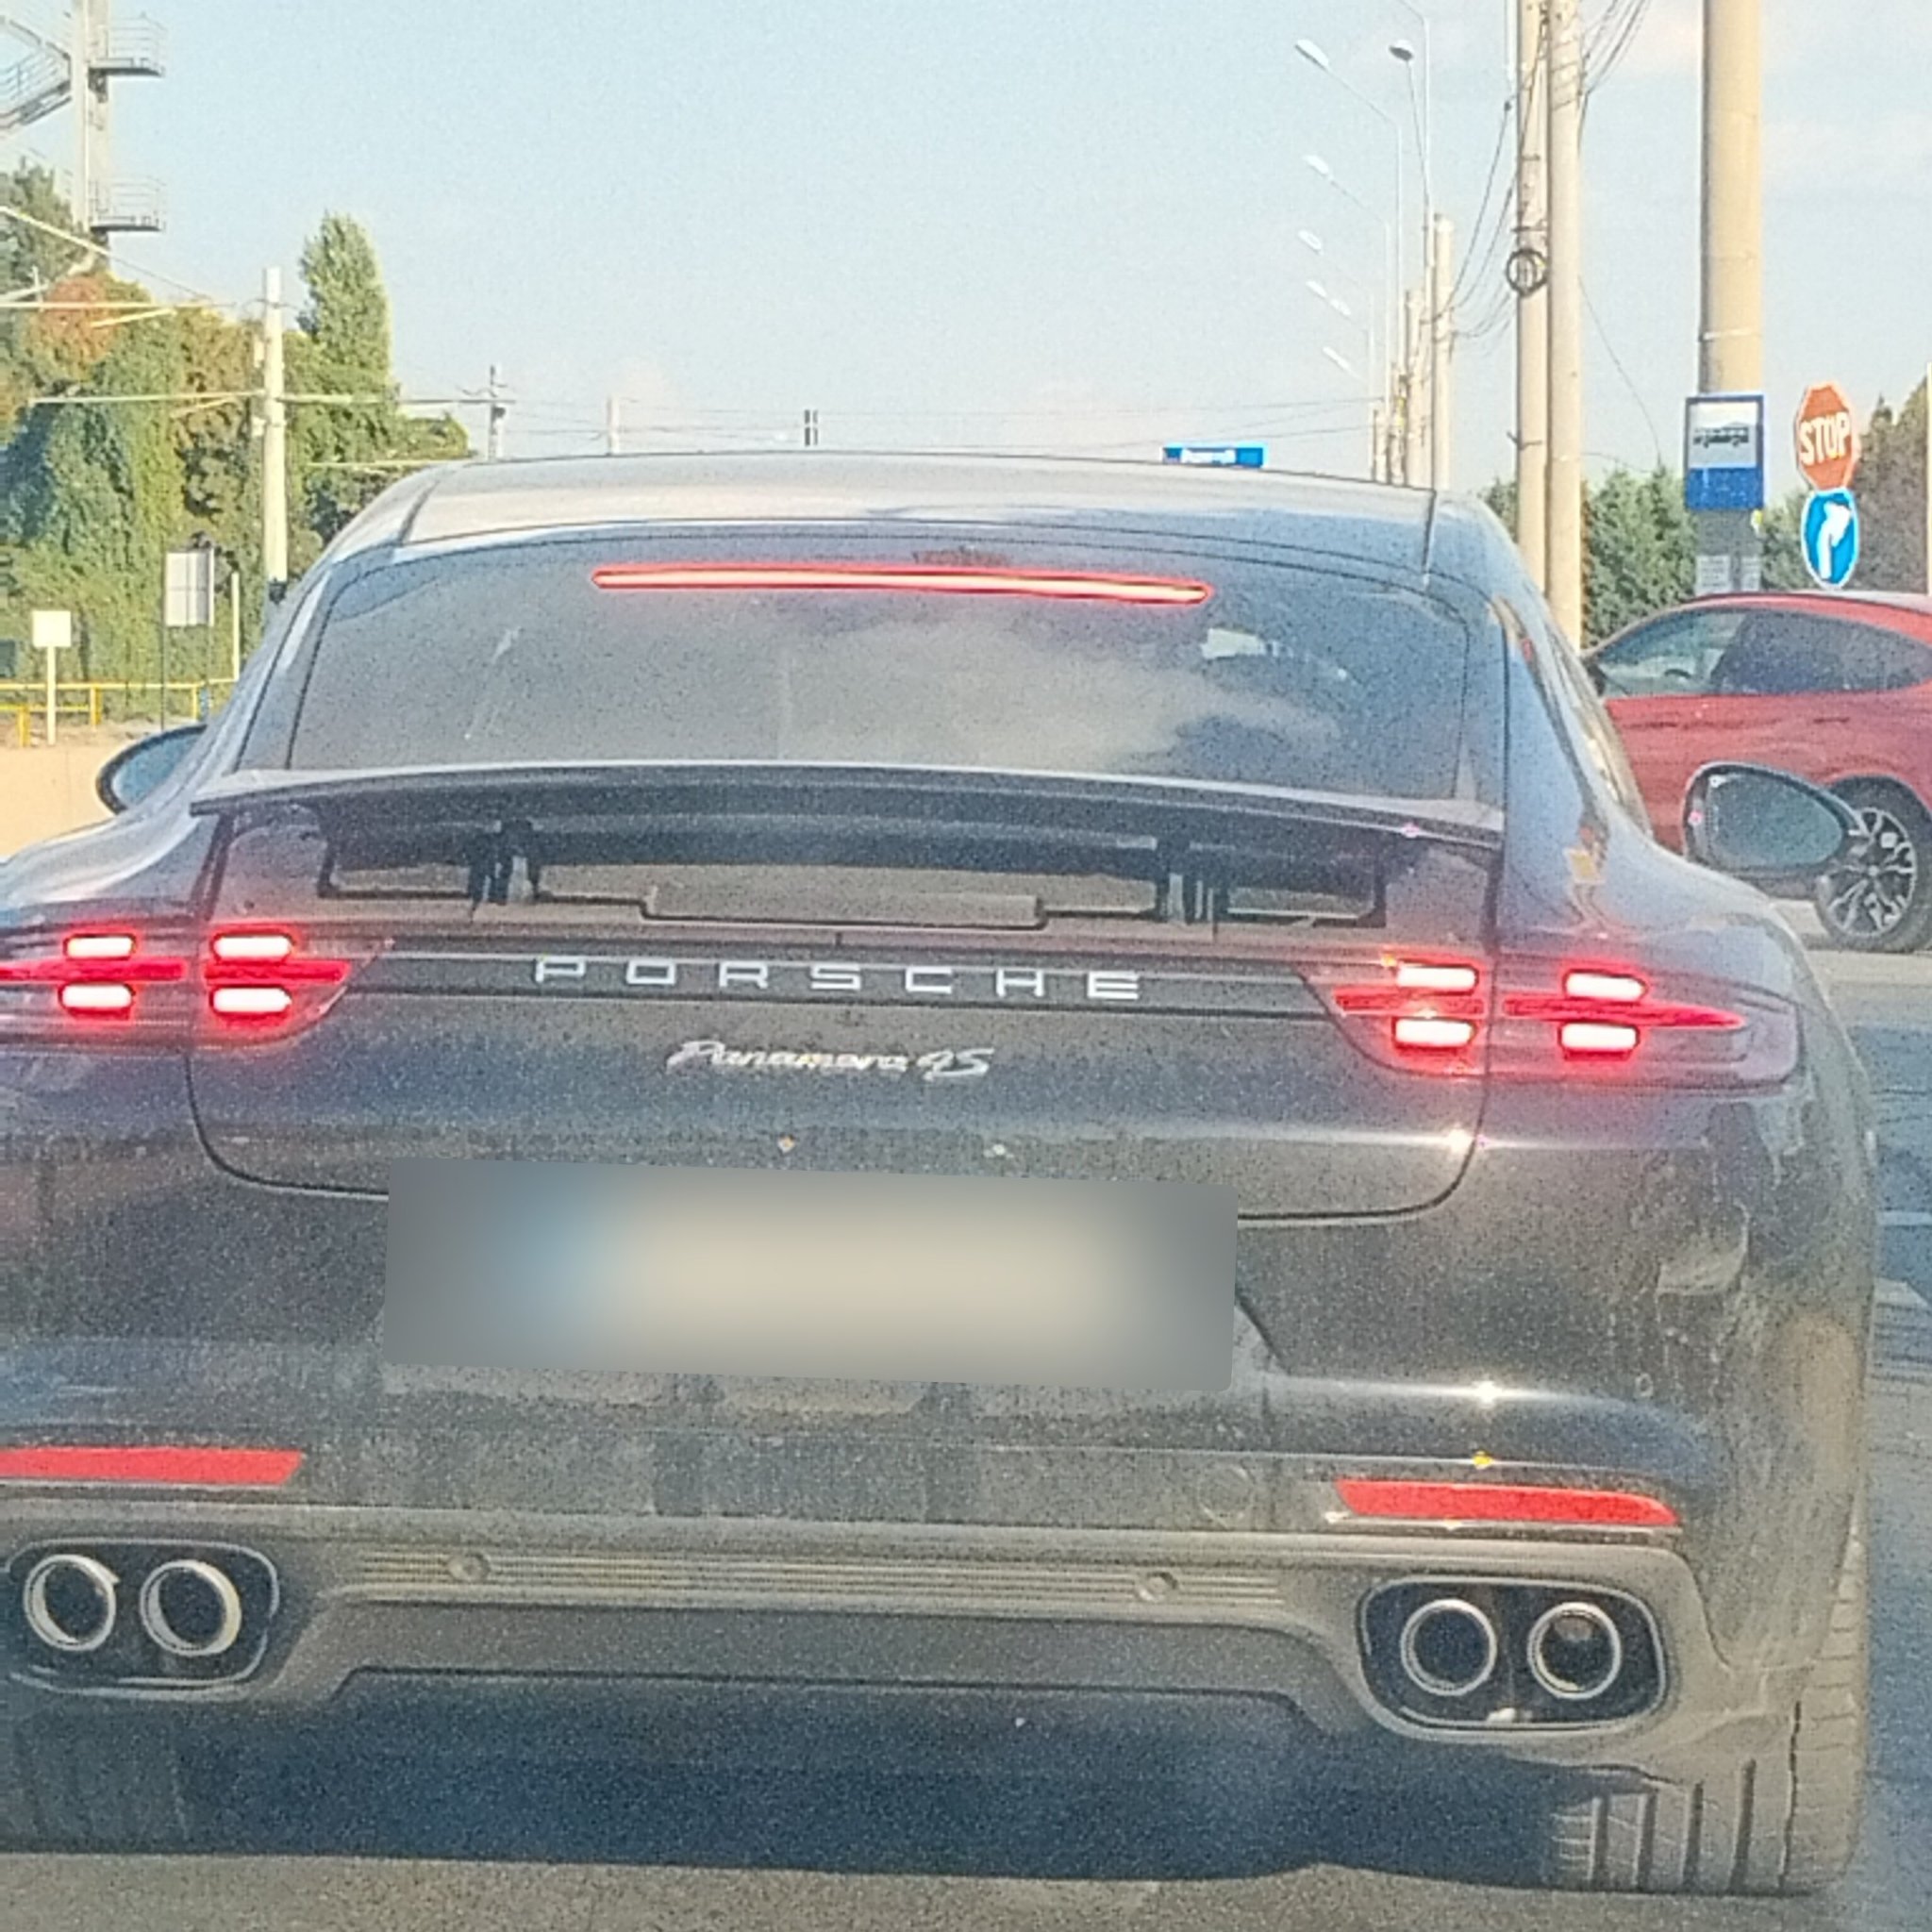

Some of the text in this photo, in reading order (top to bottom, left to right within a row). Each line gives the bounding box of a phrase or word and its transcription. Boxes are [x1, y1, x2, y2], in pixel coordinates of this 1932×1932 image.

[1799, 412, 1850, 465] STOP
[535, 956, 1140, 1000] PORSCHE
[666, 1041, 908, 1073] Panamera
